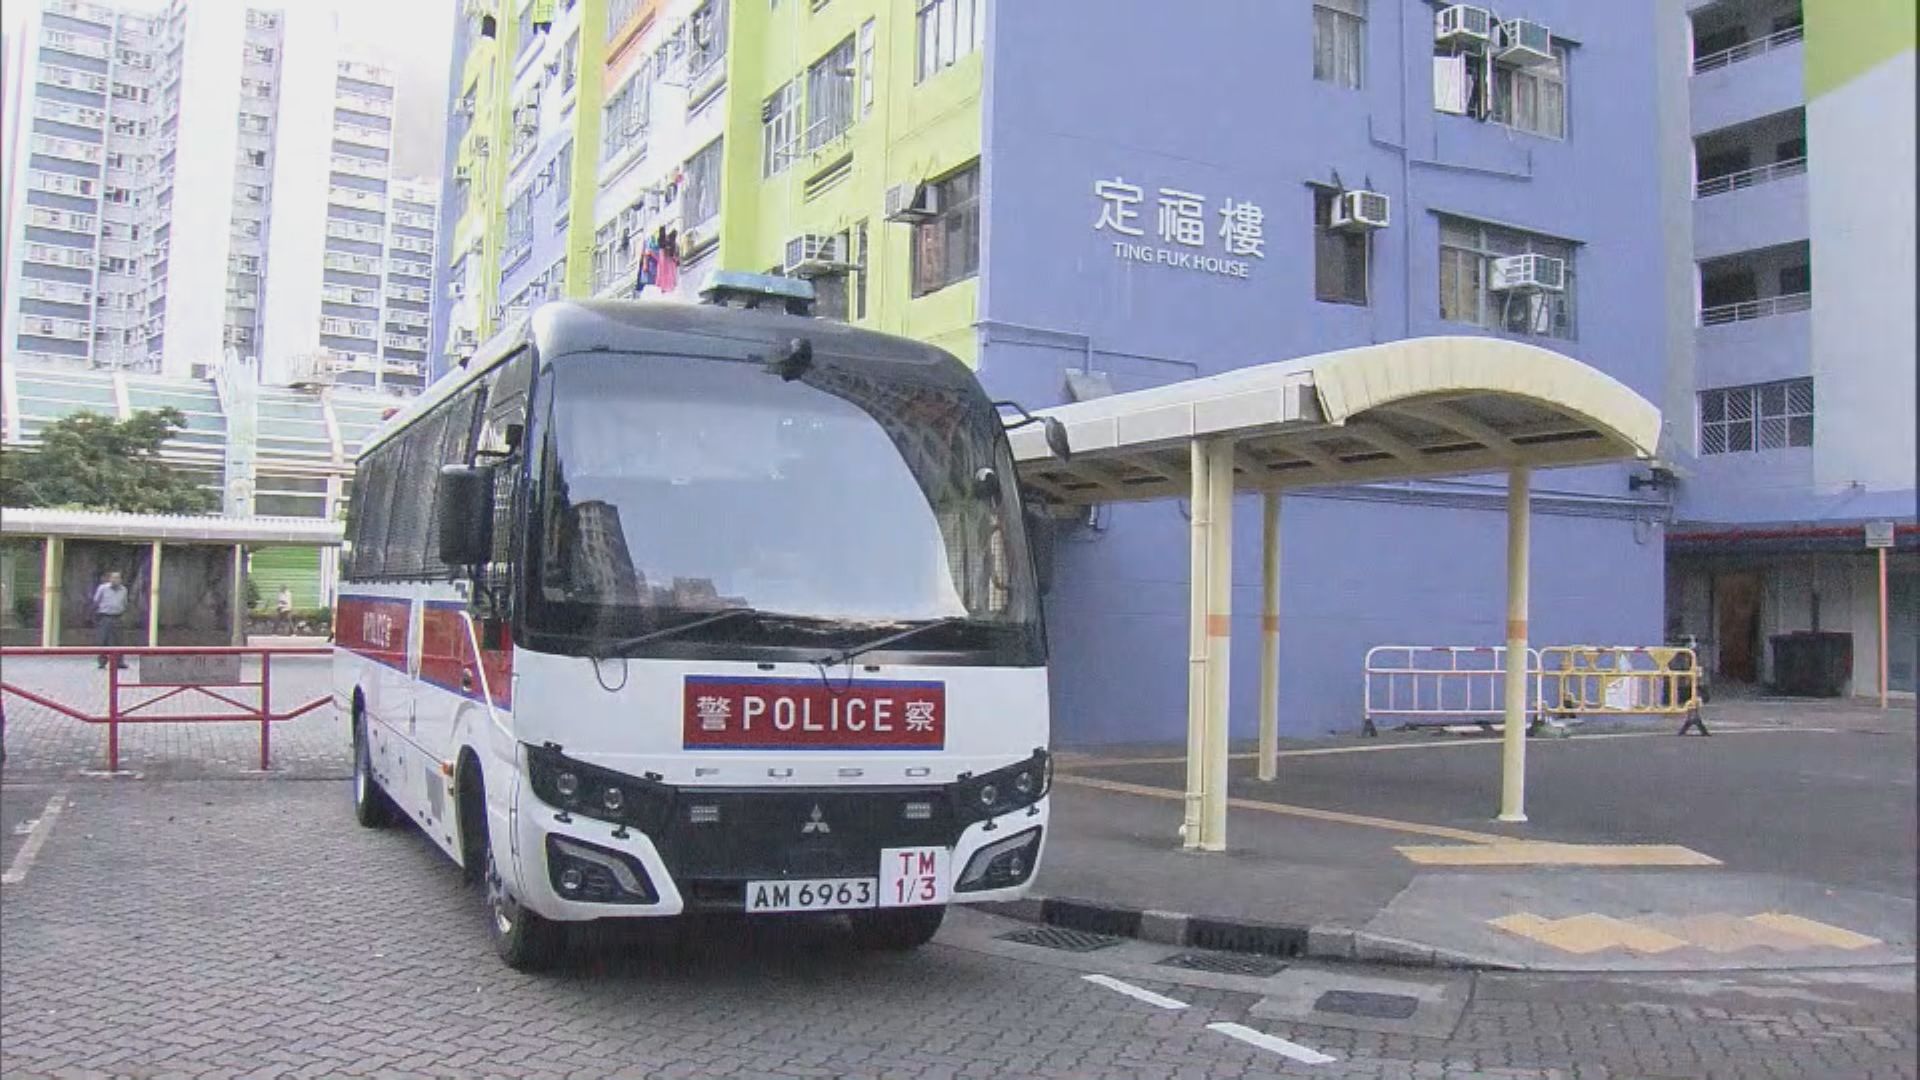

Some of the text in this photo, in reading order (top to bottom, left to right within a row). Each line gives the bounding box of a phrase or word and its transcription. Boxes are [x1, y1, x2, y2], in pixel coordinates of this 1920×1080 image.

[1094, 176, 1265, 258] 定福樓
[1113, 241, 1250, 278] TING FUK HOUSE
[696, 696, 936, 732] 警 POLICE 察
[695, 767, 931, 778] FUSO
[899, 851, 936, 876] TM
[754, 881, 871, 908] AM 6963
[896, 876, 937, 904] 1/3
